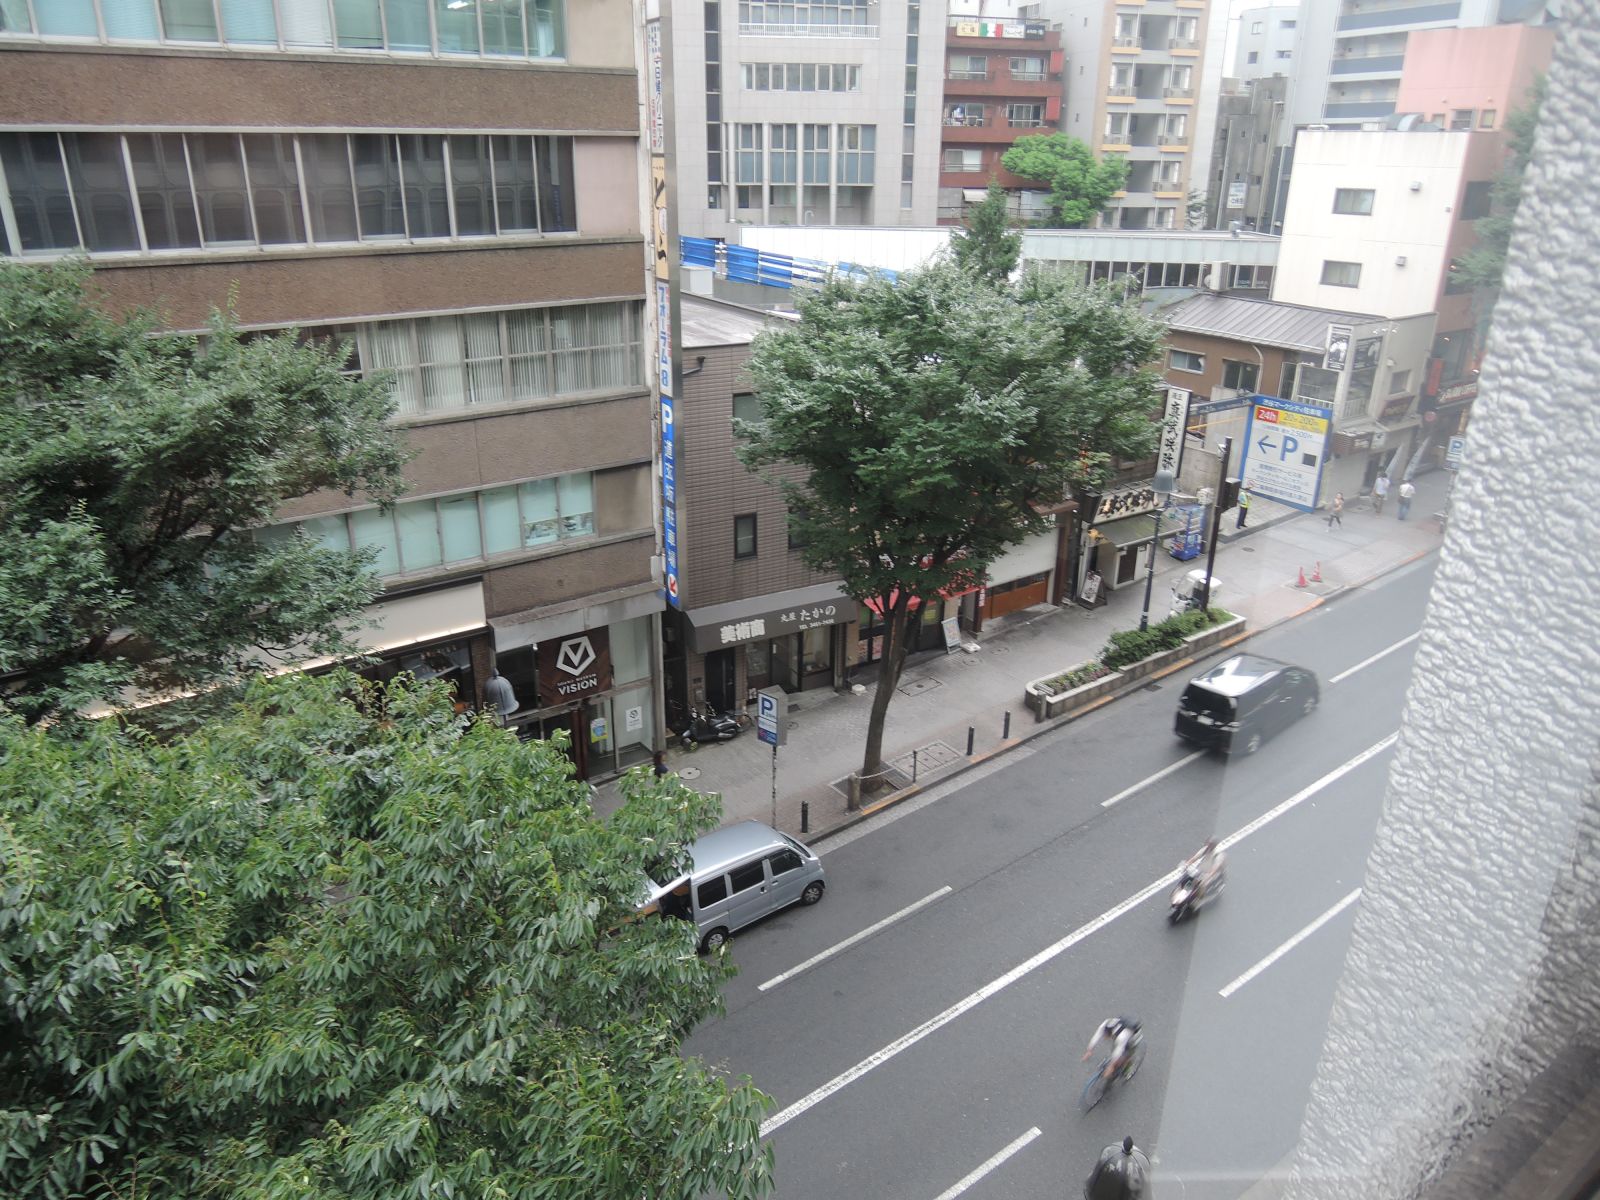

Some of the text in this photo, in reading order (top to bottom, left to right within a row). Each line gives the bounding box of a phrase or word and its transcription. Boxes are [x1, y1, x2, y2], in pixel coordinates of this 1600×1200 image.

[662, 402, 673, 433] P
[1258, 409, 1277, 421] 24h
[1280, 435, 1298, 461] P
[800, 605, 836, 621] たかの
[720, 618, 765, 644] 美術商
[558, 677, 598, 695] VISION
[761, 696, 773, 715] P
